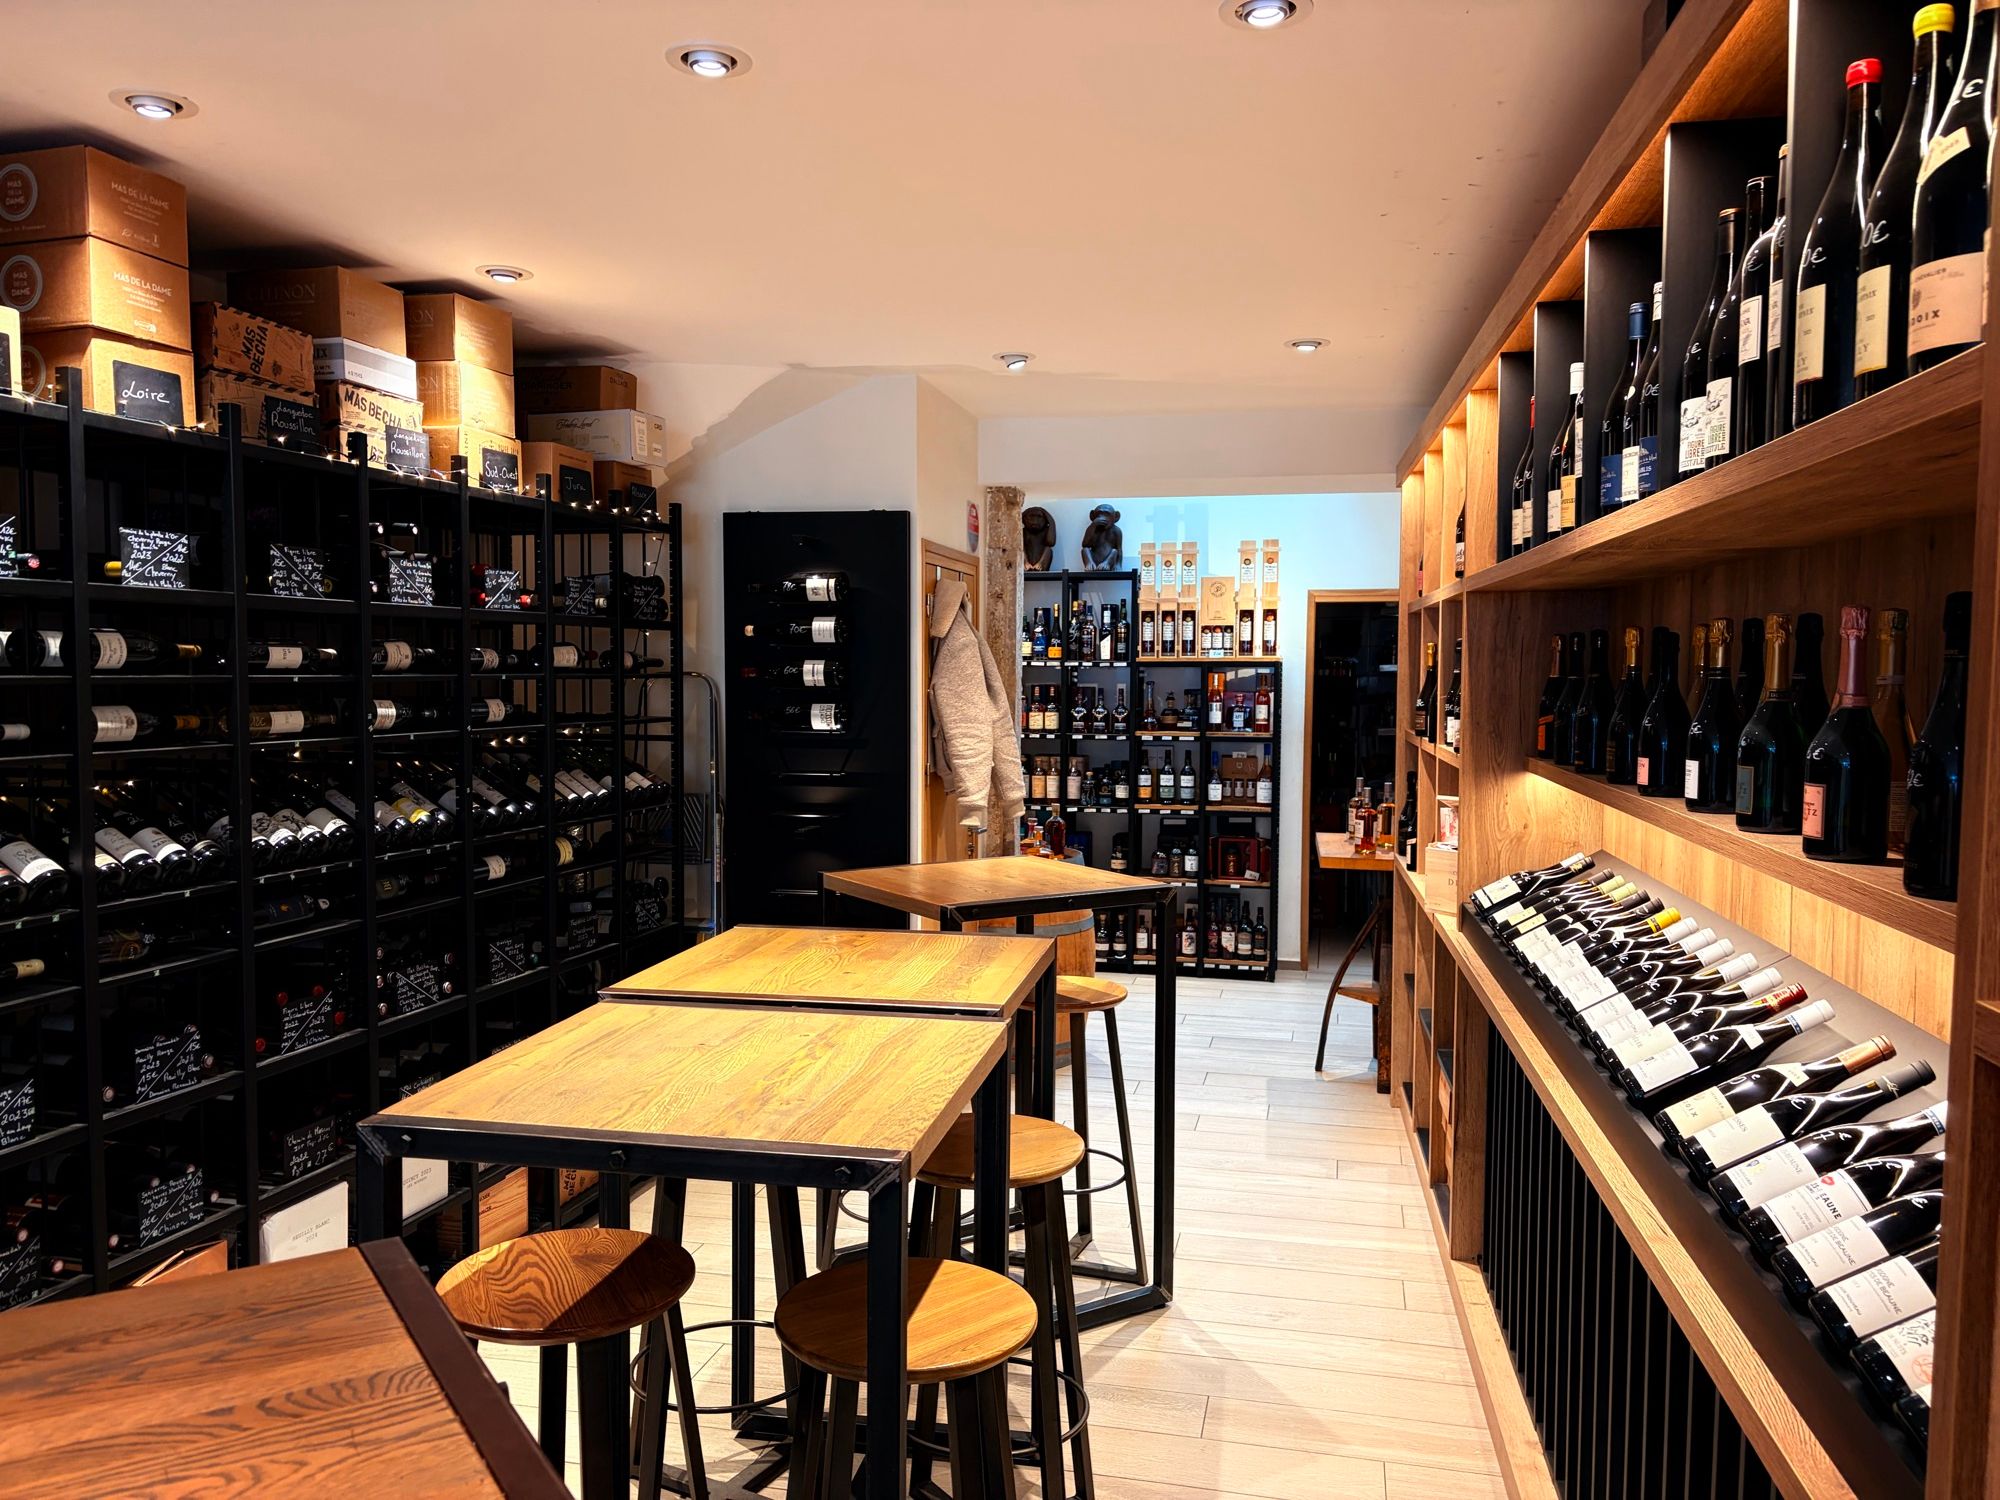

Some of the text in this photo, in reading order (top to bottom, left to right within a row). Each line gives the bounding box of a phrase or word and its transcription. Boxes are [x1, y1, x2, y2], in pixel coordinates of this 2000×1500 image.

[7, 181, 22, 189] MAS
[111, 181, 170, 210] MAS DE LA DAME
[13, 271, 28, 279] MAS
[12, 288, 30, 296] DAME
[113, 271, 173, 297] MAS DE LA DAME
[240, 326, 256, 360] MAS
[250, 325, 268, 374] BECHA
[122, 381, 170, 404] Loire
[276, 400, 314, 419] Languedoc
[344, 387, 402, 428] MAS BECHA
[271, 411, 316, 436] Roussillon
[394, 428, 426, 445] Languedoc
[390, 441, 426, 459] Roussillon
[485, 461, 518, 480] Sud-Ouest
[564, 476, 586, 491] Jura
[127, 535, 154, 547] Cheverny
[131, 550, 152, 559] 2023
[162, 553, 185, 563] 2022
[144, 565, 177, 581] Cheverny
[1, 1108, 28, 1125] 2023
[157, 1220, 188, 1236] Chinon
[1879, 1285, 1902, 1315] BEAUNE
